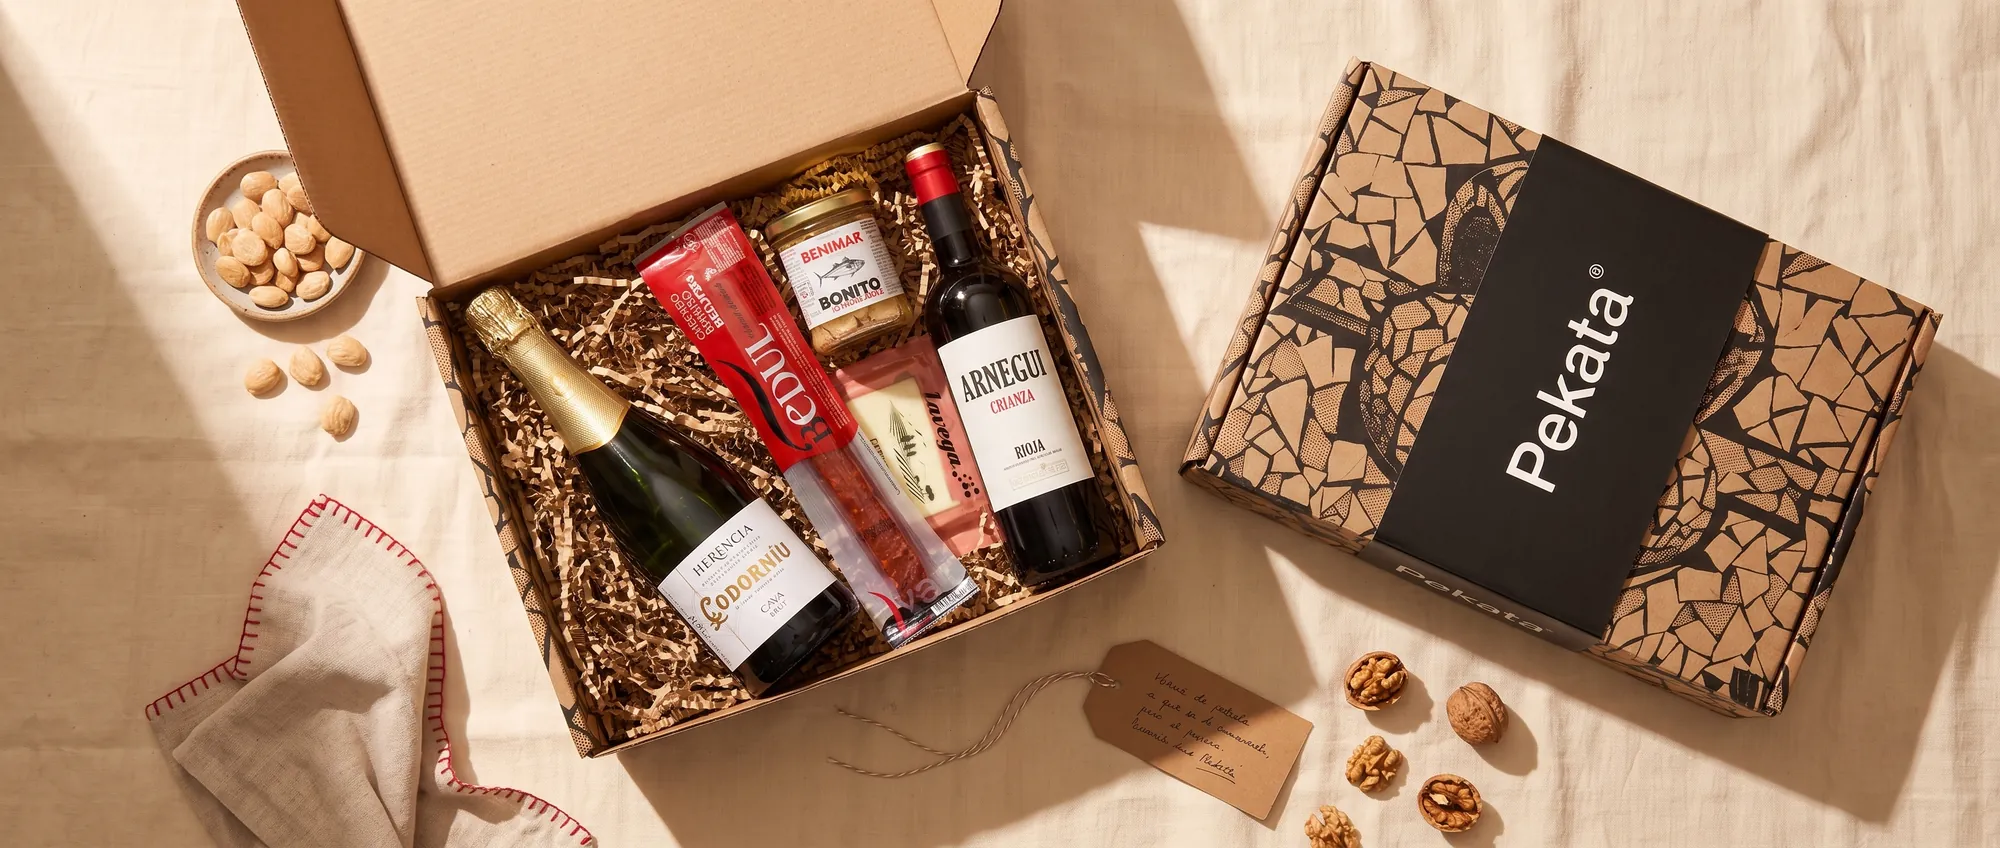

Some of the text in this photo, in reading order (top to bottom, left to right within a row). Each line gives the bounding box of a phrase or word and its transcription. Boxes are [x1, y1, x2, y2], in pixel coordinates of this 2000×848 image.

[800, 231, 864, 264] BENIMAR
[818, 277, 881, 311] BONITO
[961, 349, 1047, 402] ARNEGUI
[990, 388, 1035, 414] CRIANZA
[1014, 439, 1045, 460] RIOJA
[692, 524, 754, 577] HERENCIA
[760, 591, 786, 614] CAVA
[769, 600, 788, 618] BRUT
[1395, 565, 1544, 633] Pekata
